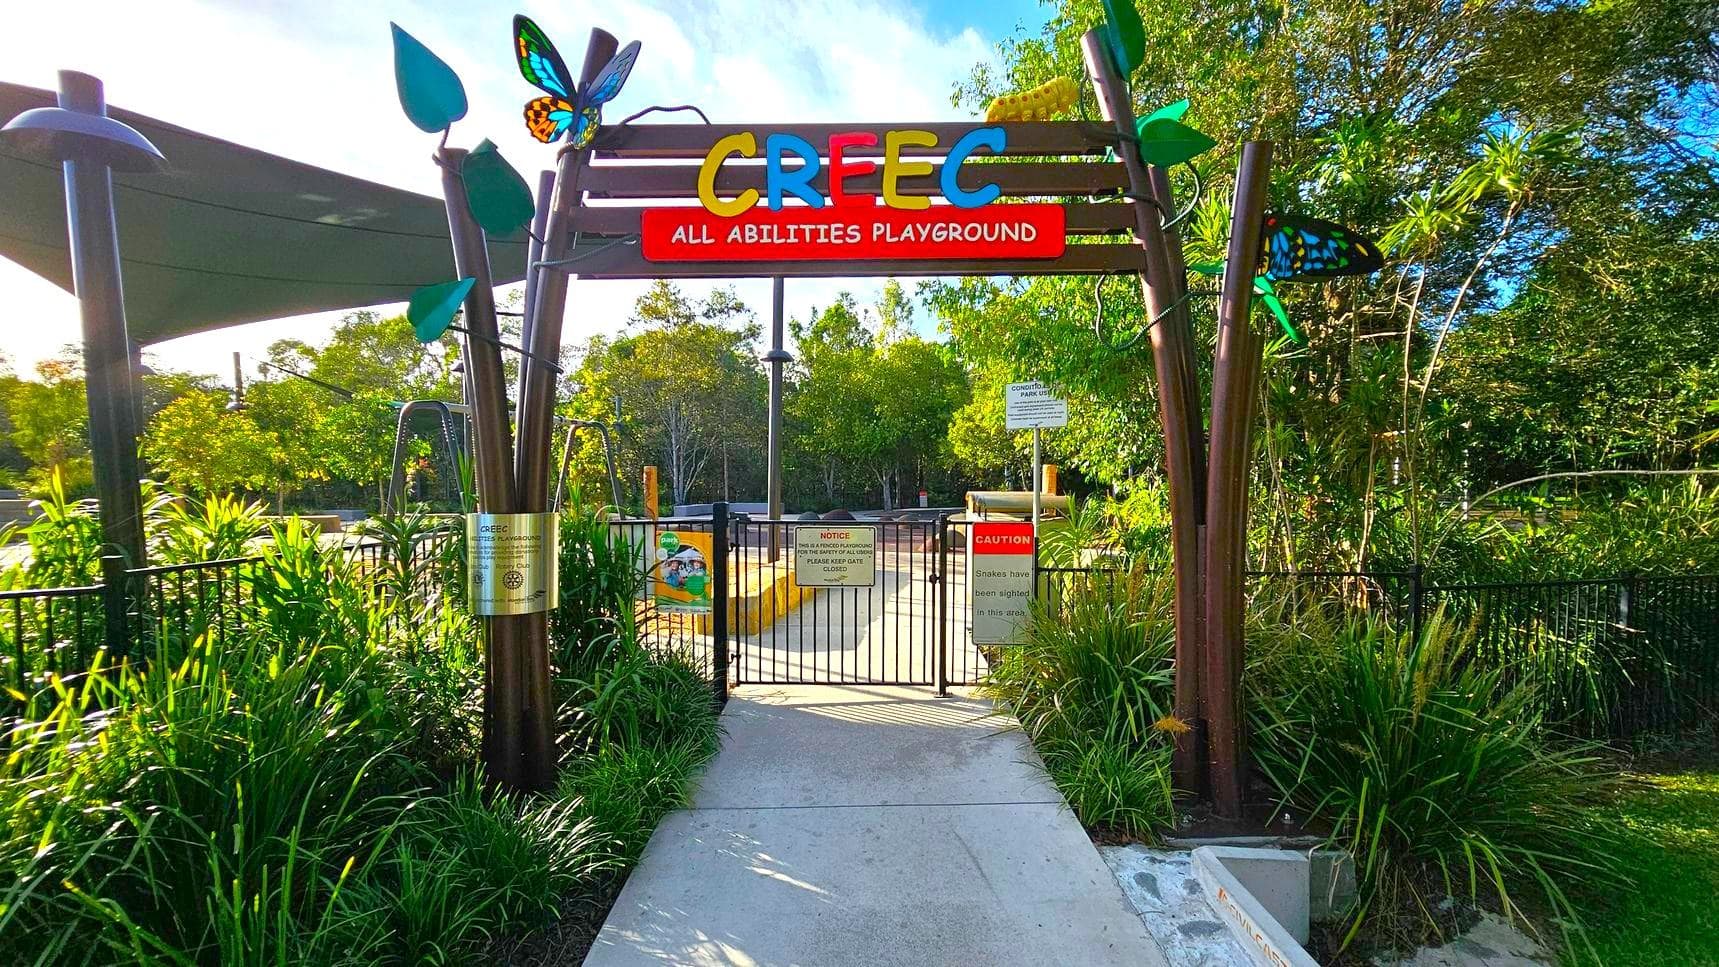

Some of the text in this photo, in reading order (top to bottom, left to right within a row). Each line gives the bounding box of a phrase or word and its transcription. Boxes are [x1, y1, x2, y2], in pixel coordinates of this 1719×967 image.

[698, 127, 1007, 217] CREEC
[671, 222, 1037, 245] ALL ABILITIES PLAYGROUND
[480, 525, 508, 533] CREEC
[820, 532, 851, 540] NOTICE
[975, 535, 1031, 545] CAUTION
[975, 569, 1030, 578] Snakes have
[975, 589, 1030, 598] been sighted
[987, 609, 1004, 617] this
